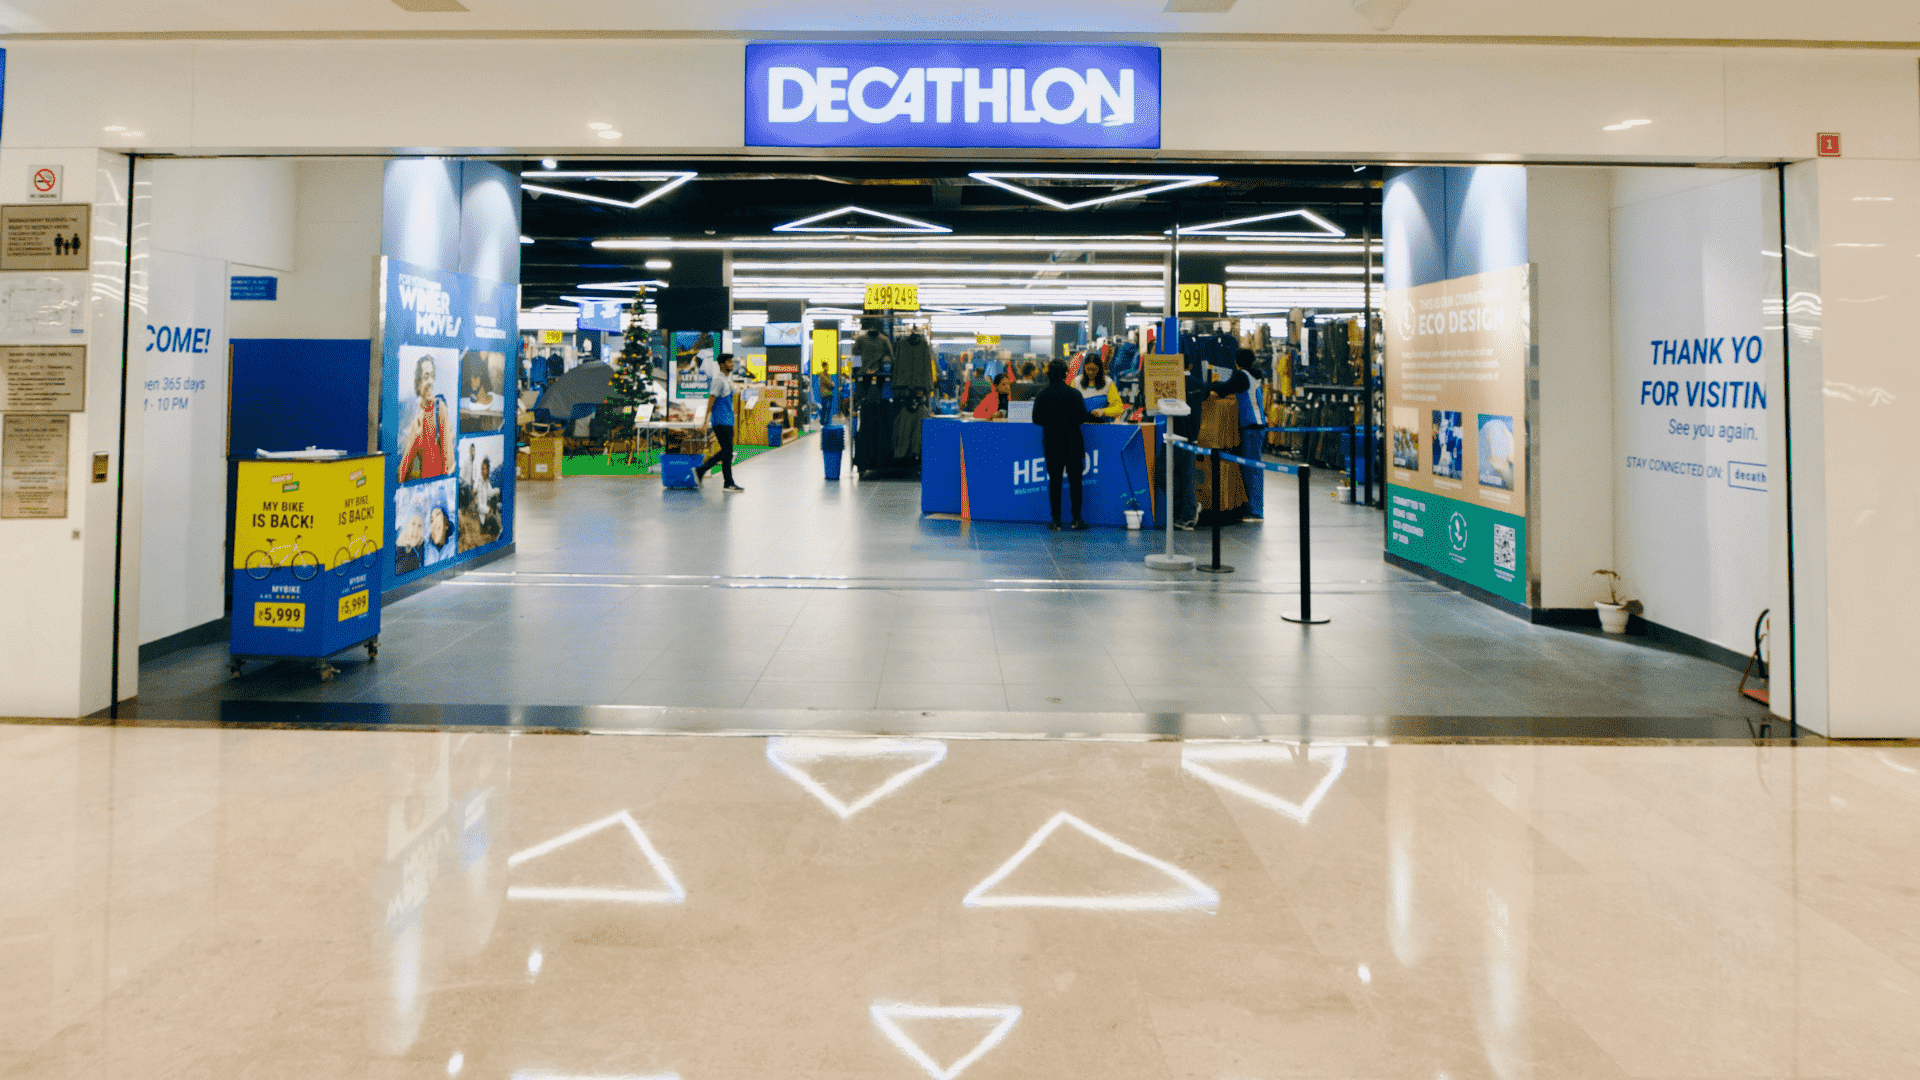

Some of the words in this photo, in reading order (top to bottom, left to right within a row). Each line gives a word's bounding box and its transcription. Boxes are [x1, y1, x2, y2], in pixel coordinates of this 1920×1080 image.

[767, 66, 1135, 126] DECATHLON
[1418, 311, 1445, 336] ECO
[1449, 303, 1505, 334] DESIGN
[1651, 337, 1725, 365] THANK
[162, 377, 181, 391] 365
[183, 377, 205, 394] days
[1641, 381, 1679, 406] FOR
[158, 397, 169, 411] 10
[172, 397, 189, 410] PM
[1669, 419, 1690, 436] See
[1693, 423, 1715, 440] you
[1718, 422, 1758, 443] again.
[1626, 456, 1647, 468] STAY
[1649, 458, 1704, 477] CONNECTED
[262, 501, 279, 512] MY
[281, 501, 304, 513] BIKE
[345, 498, 354, 509] MY
[355, 495, 369, 506] BIKE
[252, 514, 266, 528] IS
[270, 514, 314, 529] BACK!
[338, 512, 347, 526] IS
[349, 506, 374, 524] BACK!
[272, 585, 301, 594] MYBIKE
